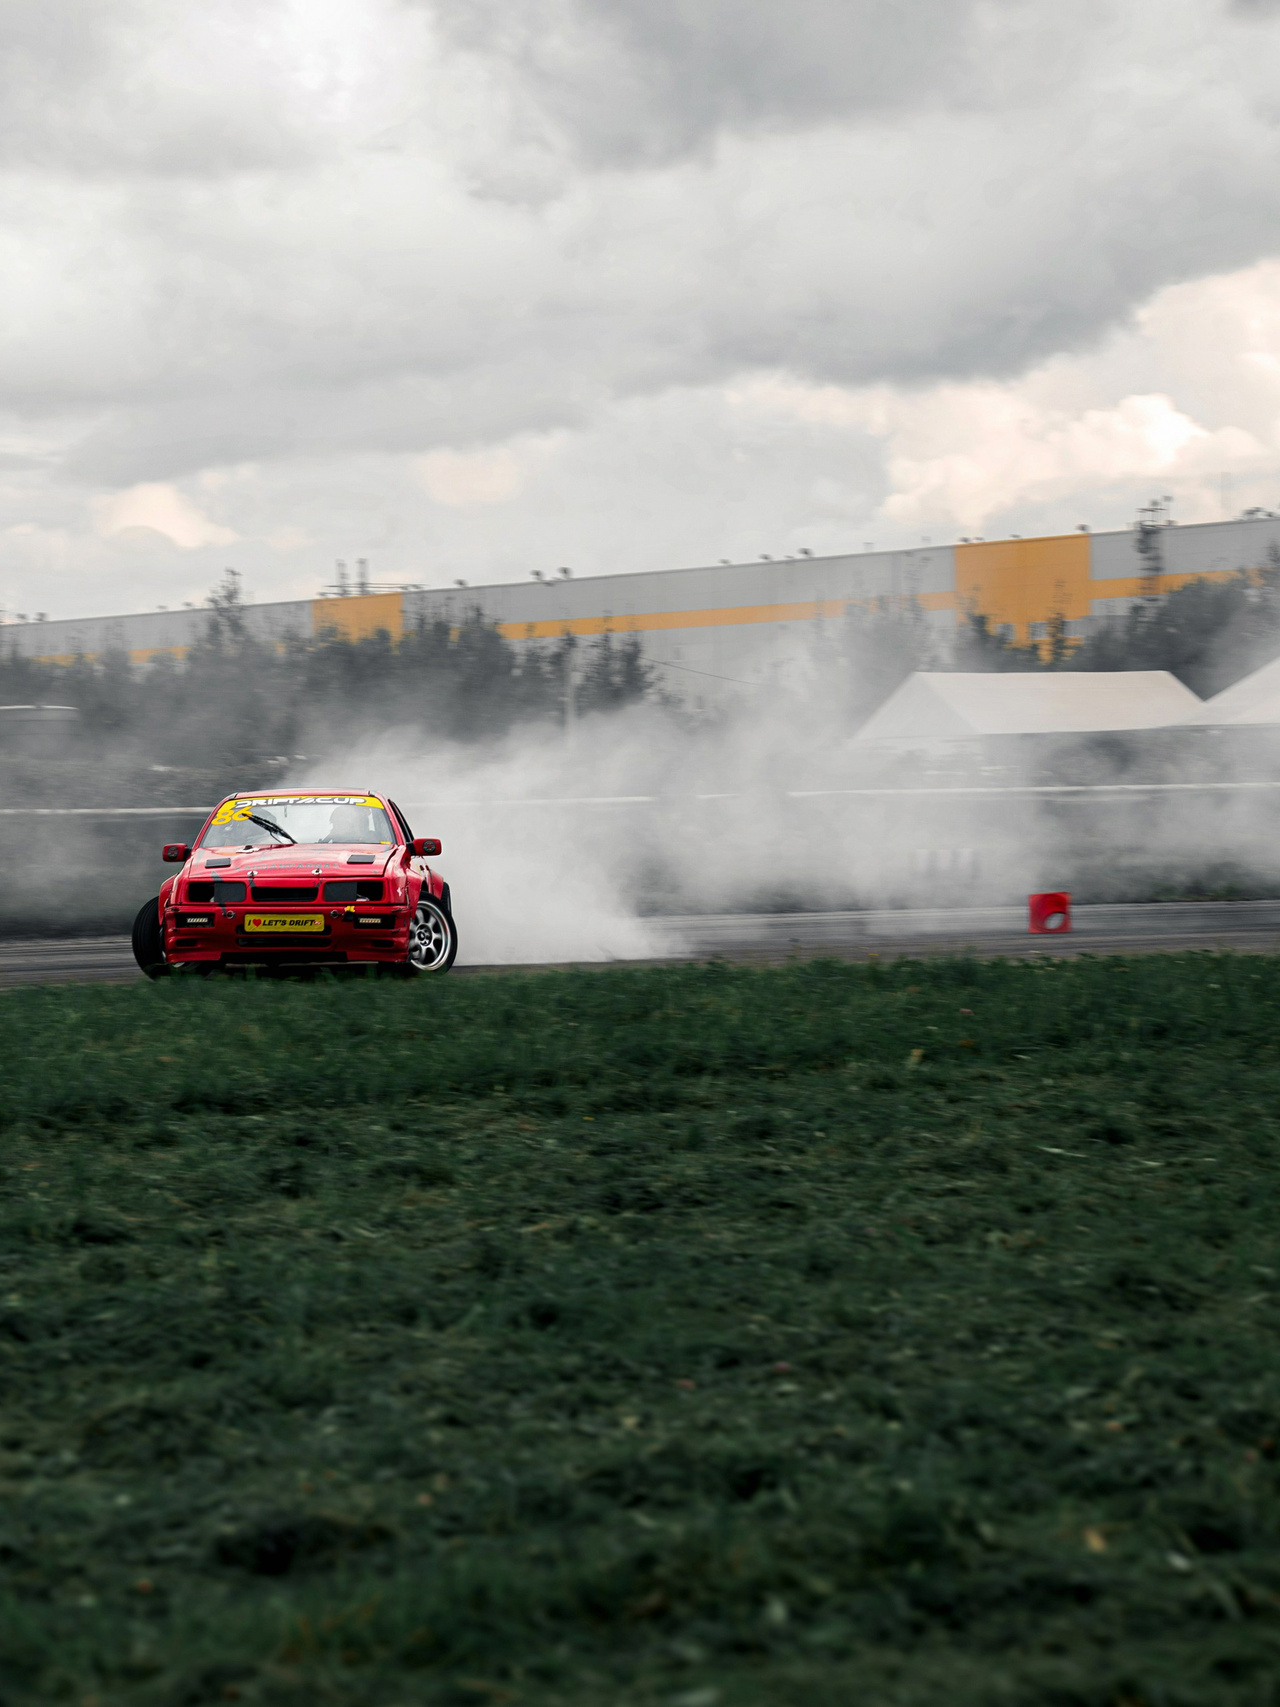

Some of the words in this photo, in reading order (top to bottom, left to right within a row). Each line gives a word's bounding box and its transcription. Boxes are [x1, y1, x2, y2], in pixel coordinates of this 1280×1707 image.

[315, 797, 366, 805] CUP
[211, 806, 253, 826] 86
[247, 919, 252, 927] I
[262, 919, 288, 927] LET'S
